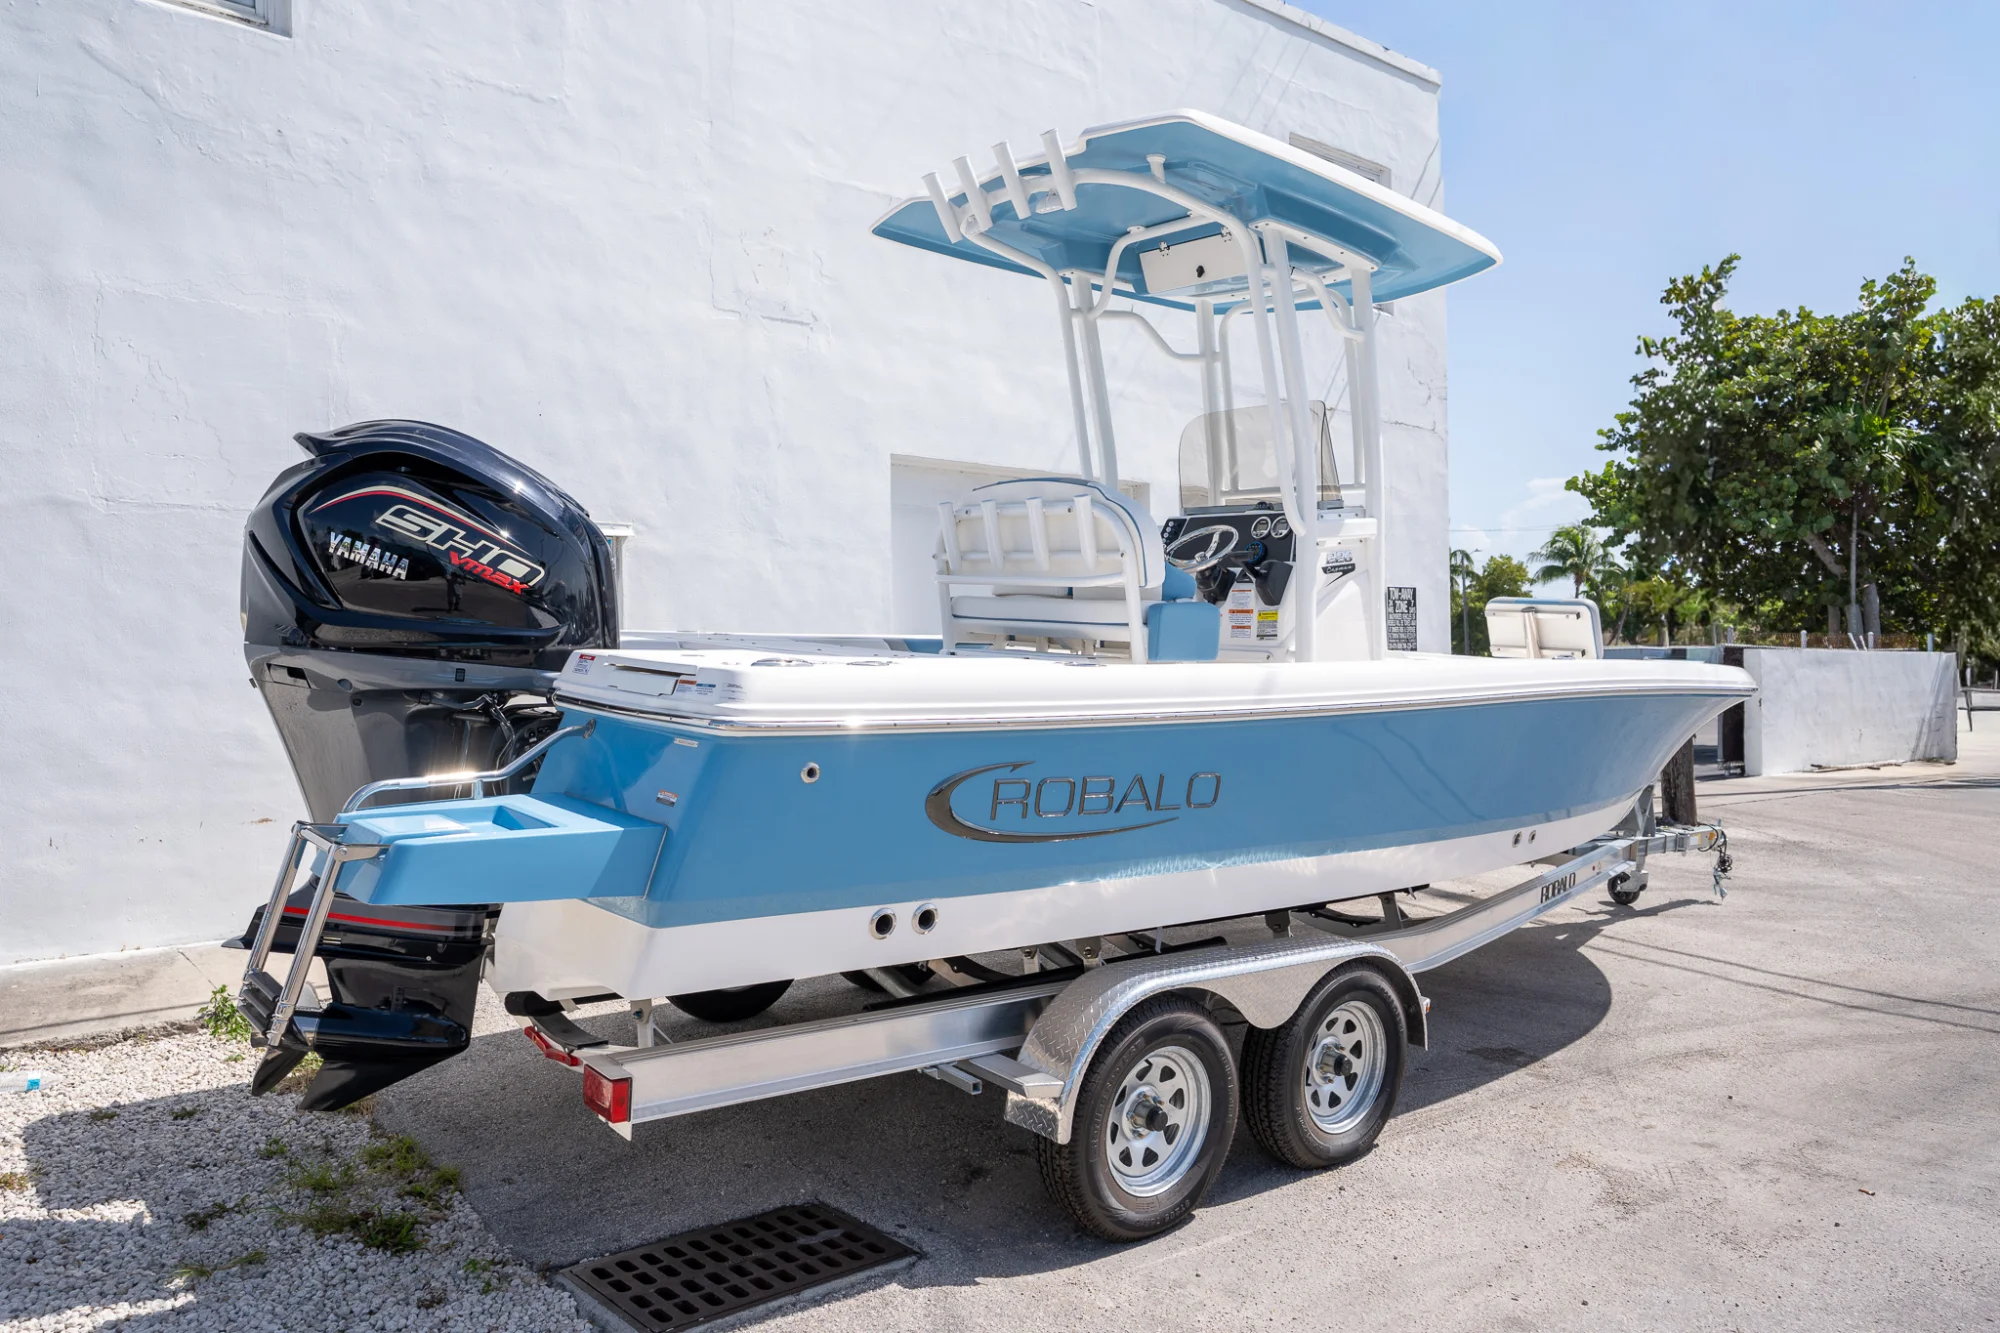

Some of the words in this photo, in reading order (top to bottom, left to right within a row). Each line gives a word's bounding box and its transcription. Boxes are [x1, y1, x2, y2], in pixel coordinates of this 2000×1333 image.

[328, 531, 409, 580] YAMAHA
[375, 504, 545, 587] SHO
[990, 771, 1221, 821] ROBALO
[1540, 872, 1576, 904] ROBALO
